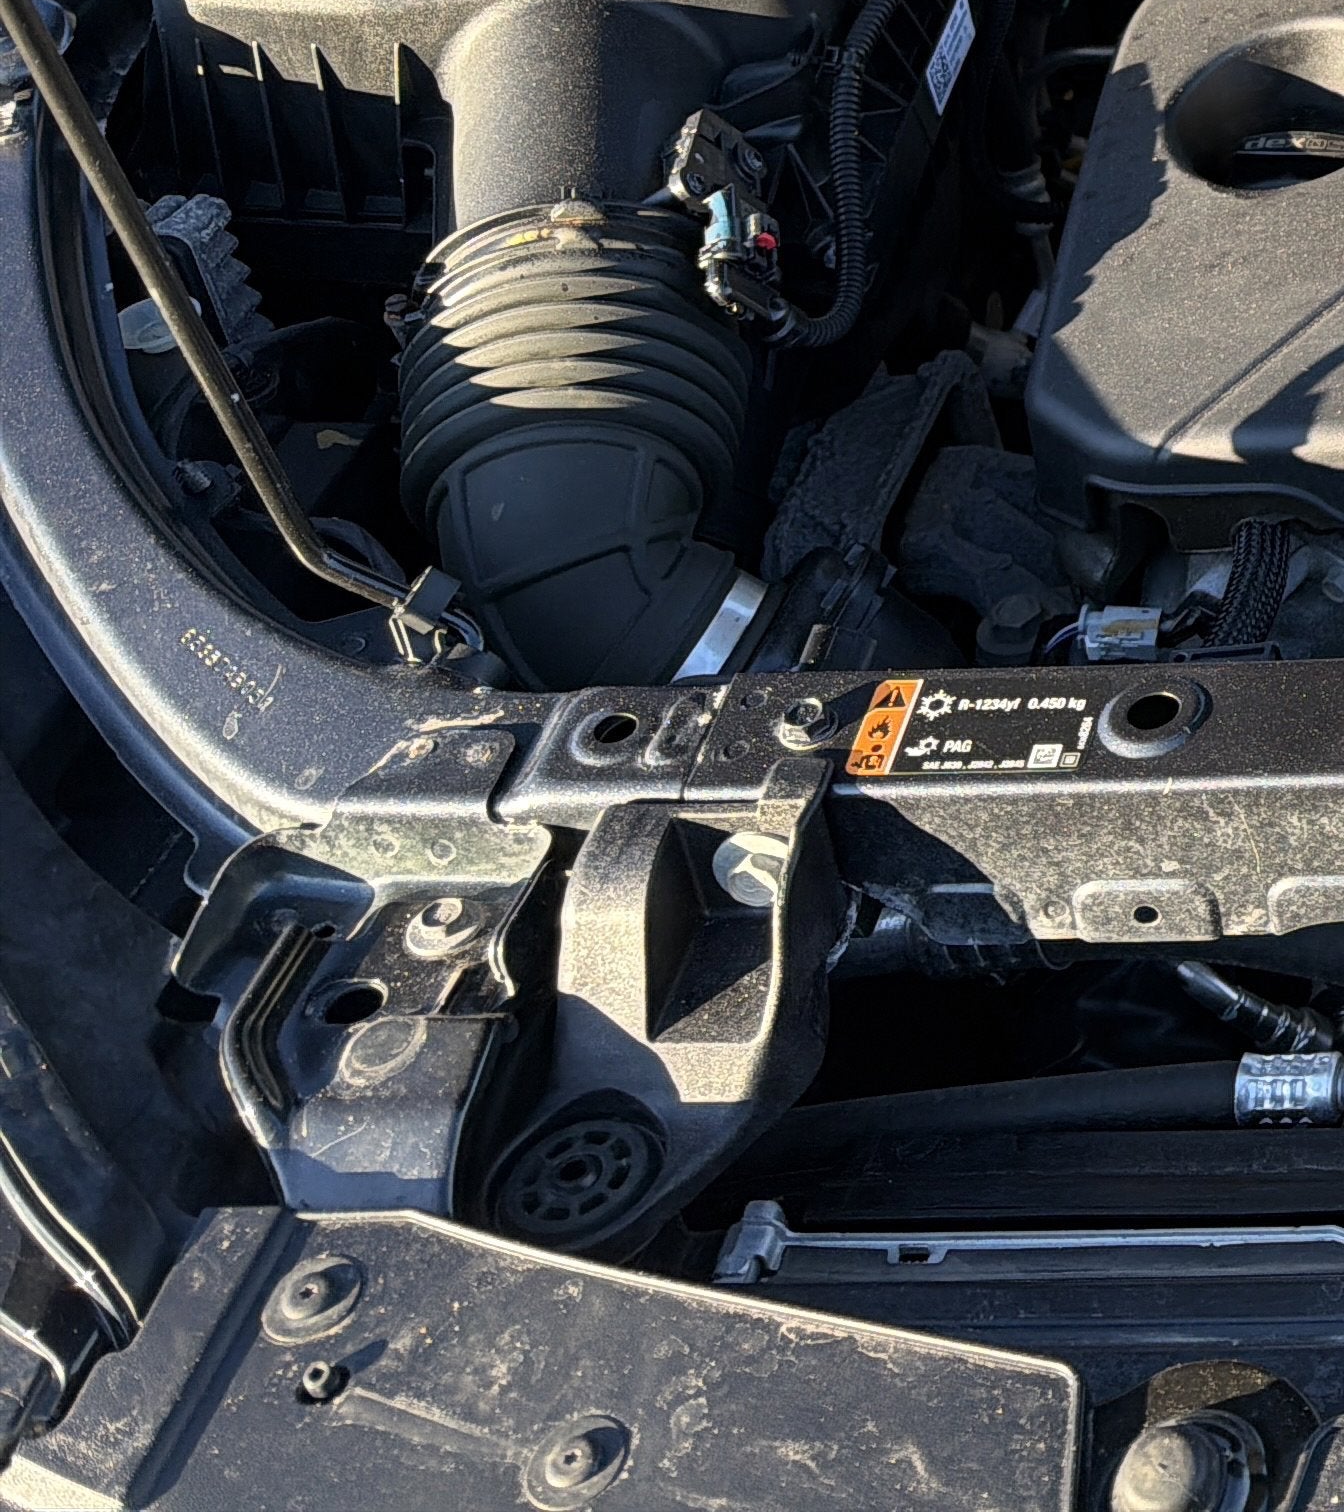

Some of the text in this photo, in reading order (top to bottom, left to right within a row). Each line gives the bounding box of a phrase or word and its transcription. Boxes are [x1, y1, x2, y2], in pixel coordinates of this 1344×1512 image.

[957, 697, 1087, 712] R-1234yf 0.450 kg
[942, 740, 973, 754] PAG
